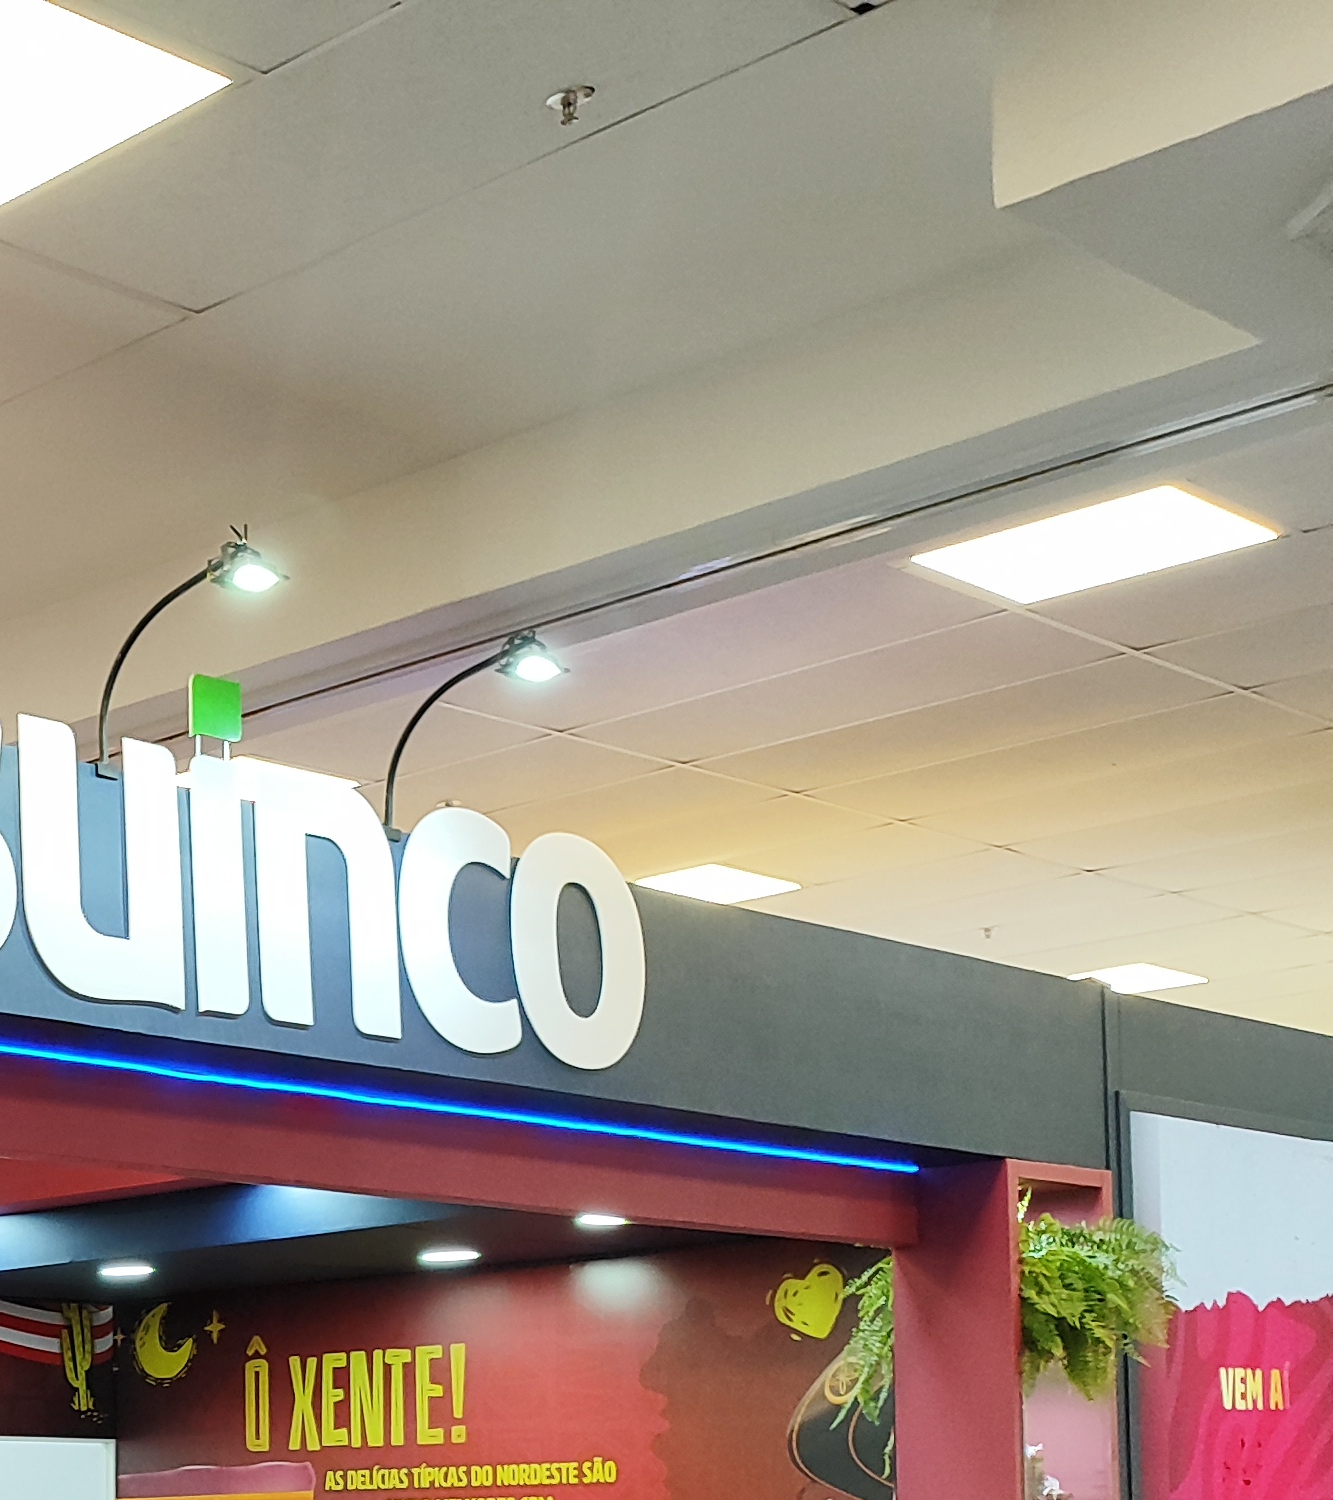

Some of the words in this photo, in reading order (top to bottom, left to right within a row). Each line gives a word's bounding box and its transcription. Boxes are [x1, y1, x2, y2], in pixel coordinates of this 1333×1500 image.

[245, 1335, 269, 1451] Ô
[288, 1343, 466, 1451] XENTE!
[1219, 1366, 1264, 1411] VEM
[325, 1470, 344, 1491] AS
[347, 1465, 408, 1490] DELÍCIAS
[410, 1463, 467, 1489] TÍPICAS
[471, 1465, 492, 1487] DO
[496, 1462, 579, 1486] NORDESTE
[583, 1457, 617, 1483] SÃO
